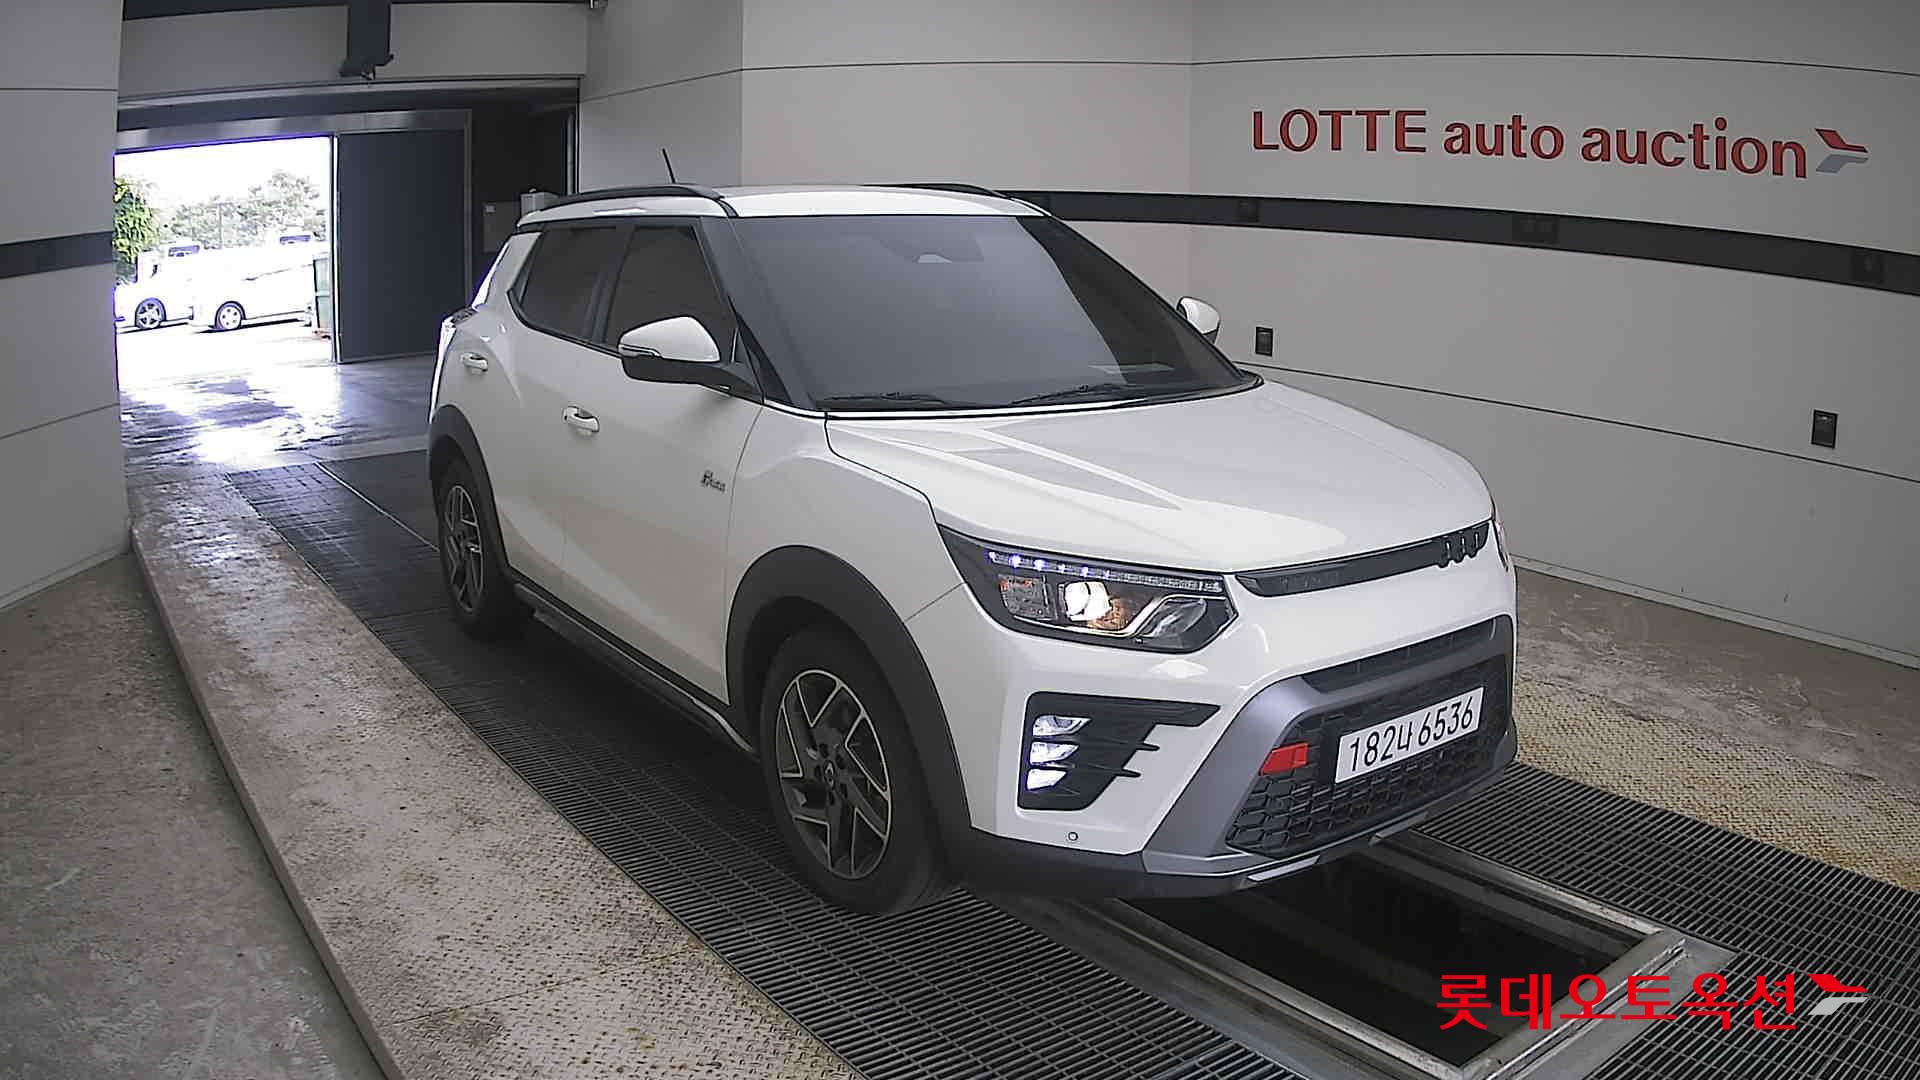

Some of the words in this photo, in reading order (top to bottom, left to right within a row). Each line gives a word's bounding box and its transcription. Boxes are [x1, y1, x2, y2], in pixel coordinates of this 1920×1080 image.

[1253, 109, 1427, 153] LOTTE
[1443, 114, 1565, 160] auto
[1581, 116, 1807, 179] auction
[1418, 696, 1473, 746] 6536
